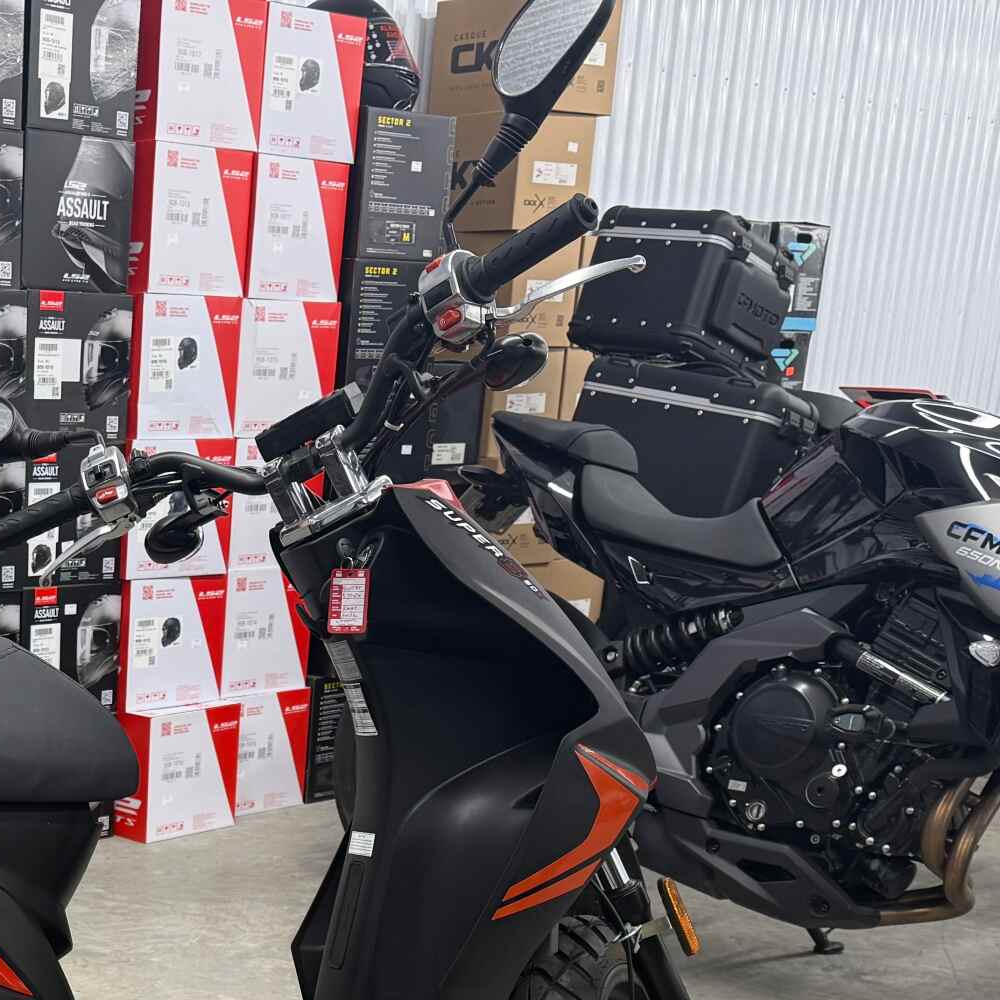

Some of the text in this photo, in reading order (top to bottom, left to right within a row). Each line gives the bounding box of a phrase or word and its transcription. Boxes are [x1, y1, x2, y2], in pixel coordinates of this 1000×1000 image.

[56, 196, 110, 220] ASSAULT
[38, 319, 66, 331] ASSAULT
[32, 464, 59, 476] ASSAULT
[425, 498, 504, 557] SUPER
[34, 608, 60, 619] ASSAULT
